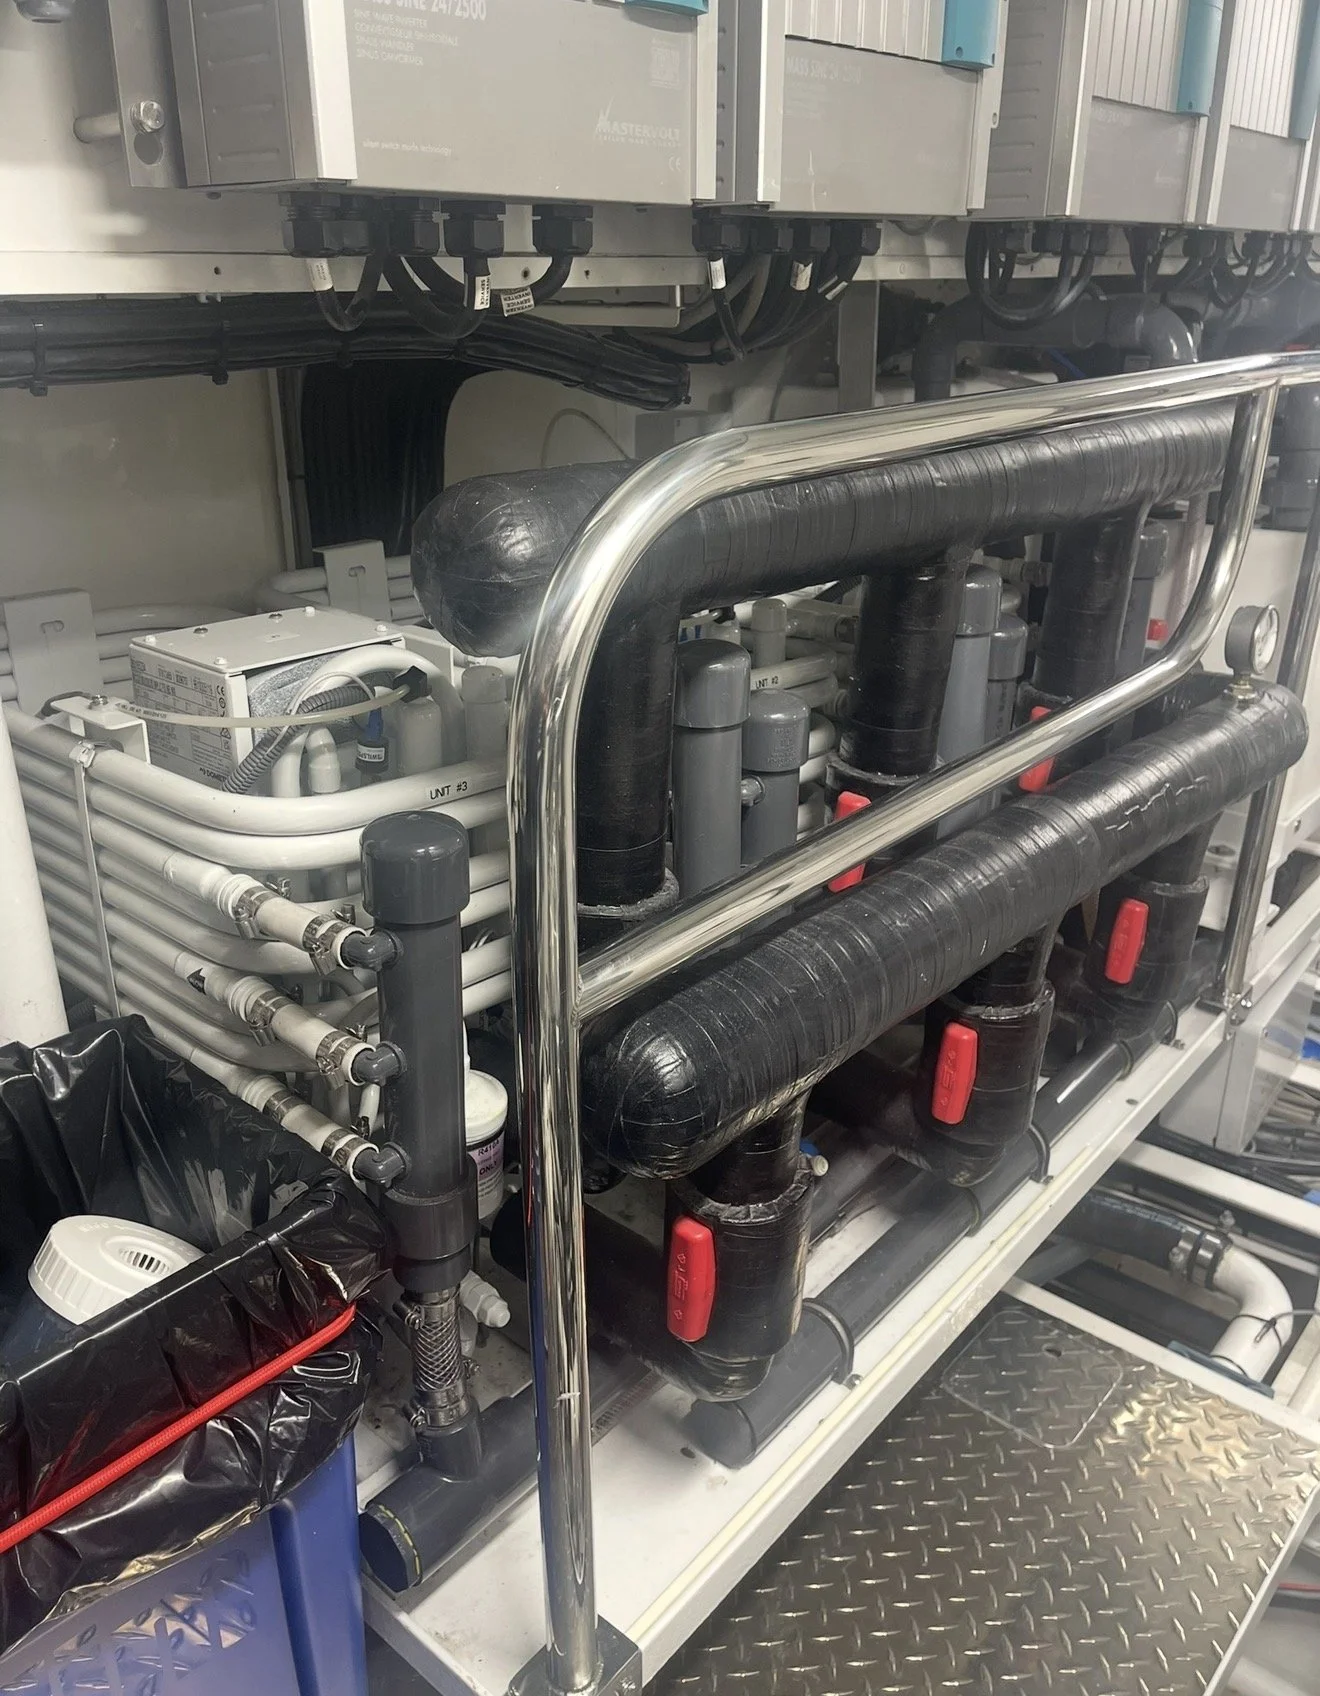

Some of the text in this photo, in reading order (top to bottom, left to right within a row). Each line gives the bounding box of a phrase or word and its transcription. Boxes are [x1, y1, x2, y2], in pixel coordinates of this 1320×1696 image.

[755, 677, 768, 690] UNIT
[430, 781, 468, 800] UNIT #3
[479, 1161, 497, 1175] ONLY
